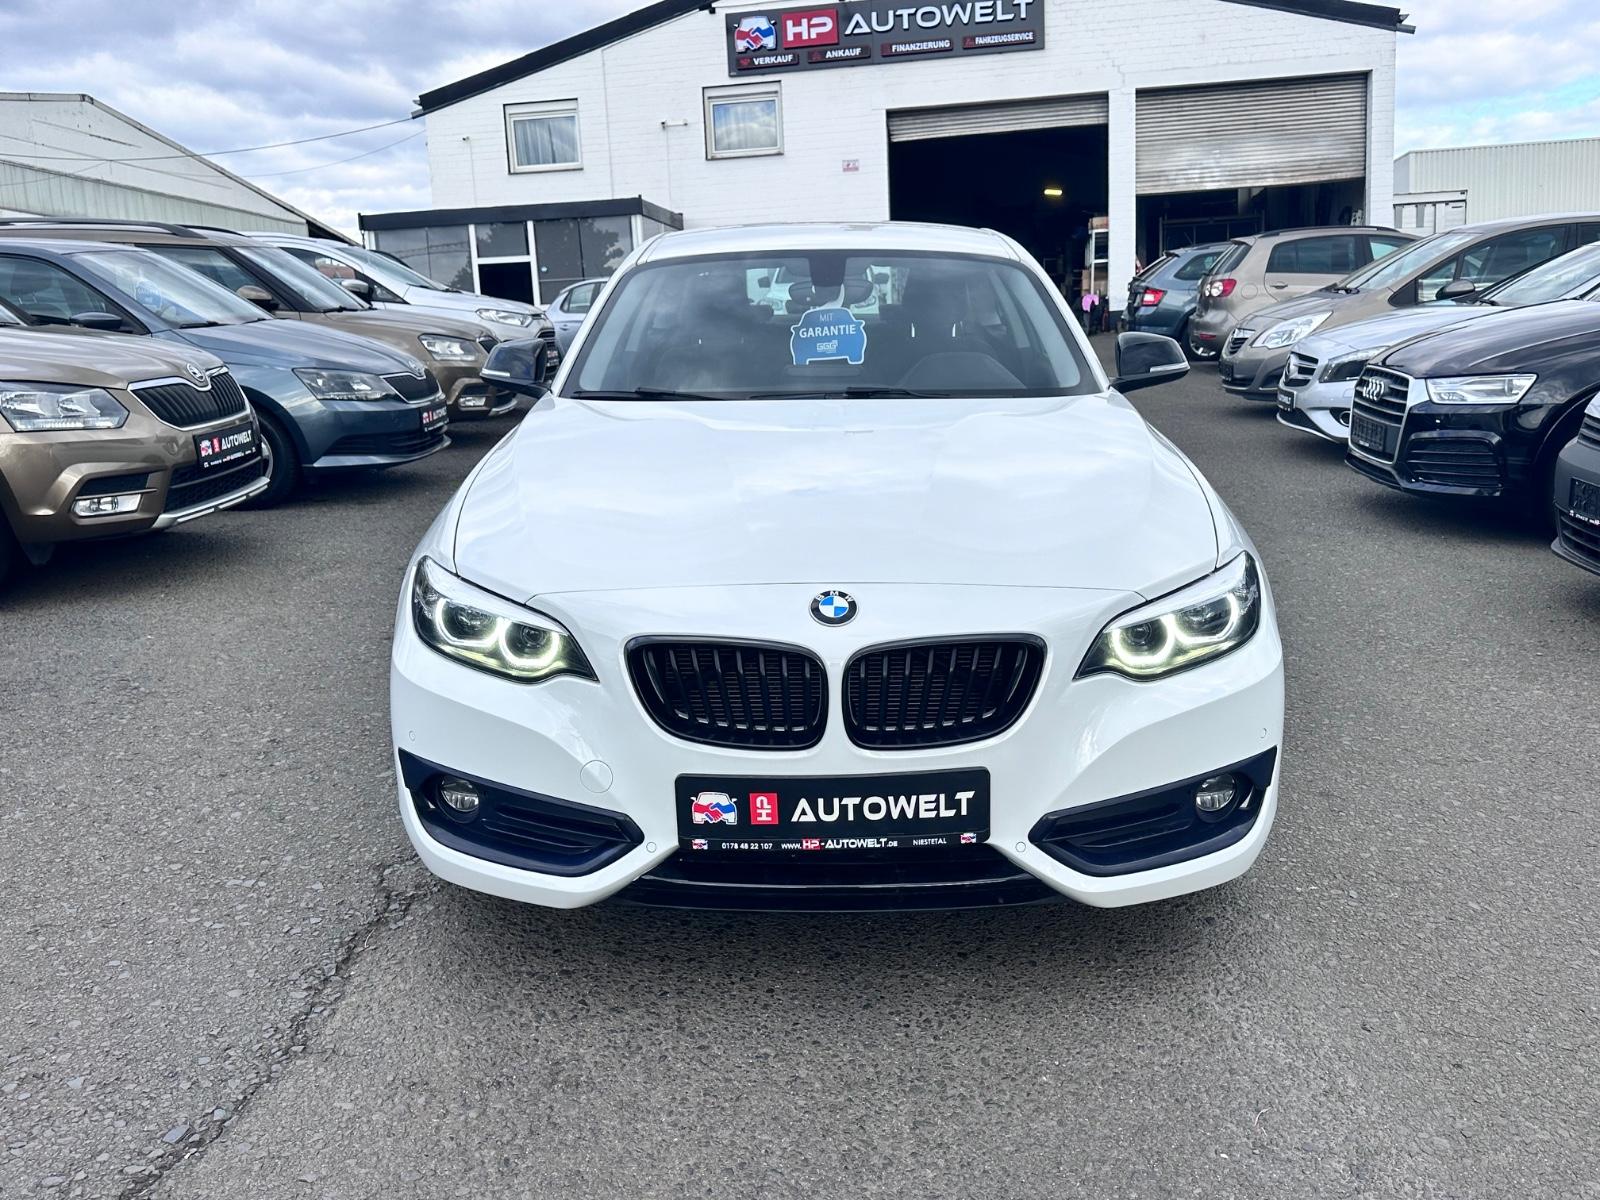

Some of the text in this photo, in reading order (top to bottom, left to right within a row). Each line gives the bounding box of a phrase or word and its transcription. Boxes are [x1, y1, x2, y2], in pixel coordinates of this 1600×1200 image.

[785, 0, 1035, 41] HP AUTOWELT
[974, 31, 1034, 45] FAHRZEUGSERVICE
[825, 47, 862, 59] ANKAUF
[891, 39, 951, 53] FINANZIERUNG
[753, 54, 793, 66] VERKAUF
[819, 312, 833, 322] MIT
[799, 324, 857, 338] GARANTIE
[221, 429, 252, 451] AUTOWELT
[790, 790, 976, 823] AUTOWELT
[721, 842, 739, 850] 0178
[750, 842, 759, 850] 22
[760, 842, 773, 850] 107
[912, 838, 947, 846] NIESTETAL
